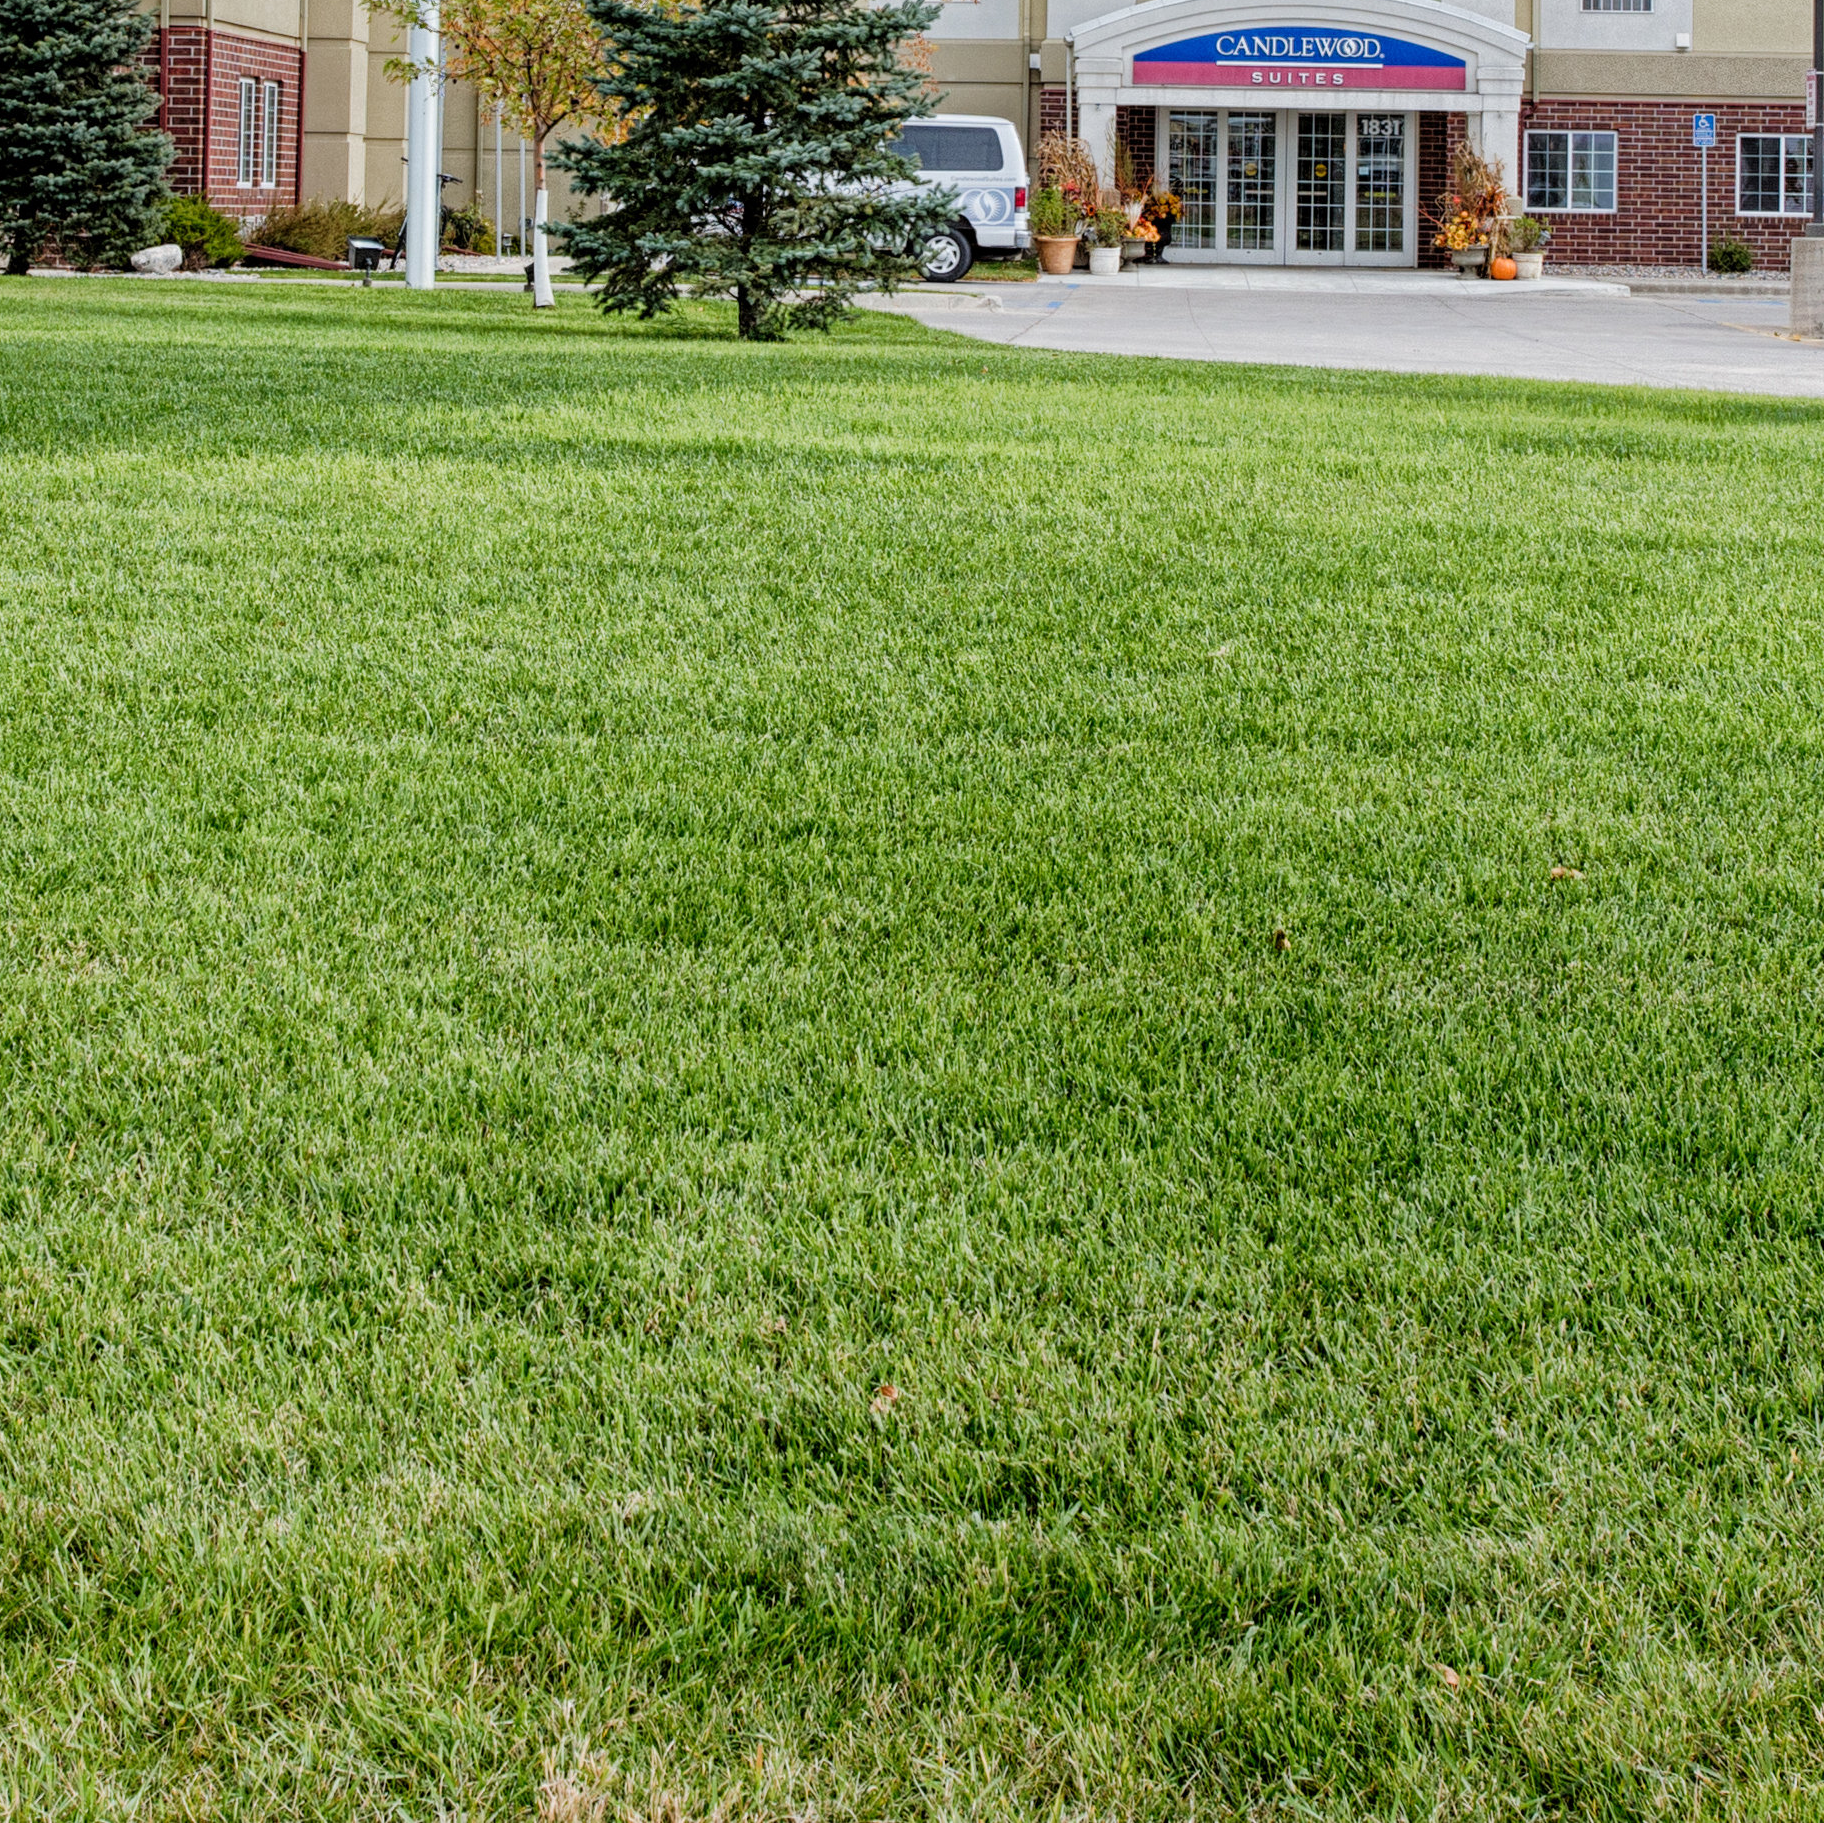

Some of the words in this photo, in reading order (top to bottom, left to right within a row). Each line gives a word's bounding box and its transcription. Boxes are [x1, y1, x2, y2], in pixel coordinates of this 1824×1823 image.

[1215, 35, 1382, 59] CANDLEWOOD
[1251, 71, 1344, 85] SUITES
[1361, 119, 1402, 136] 1831
